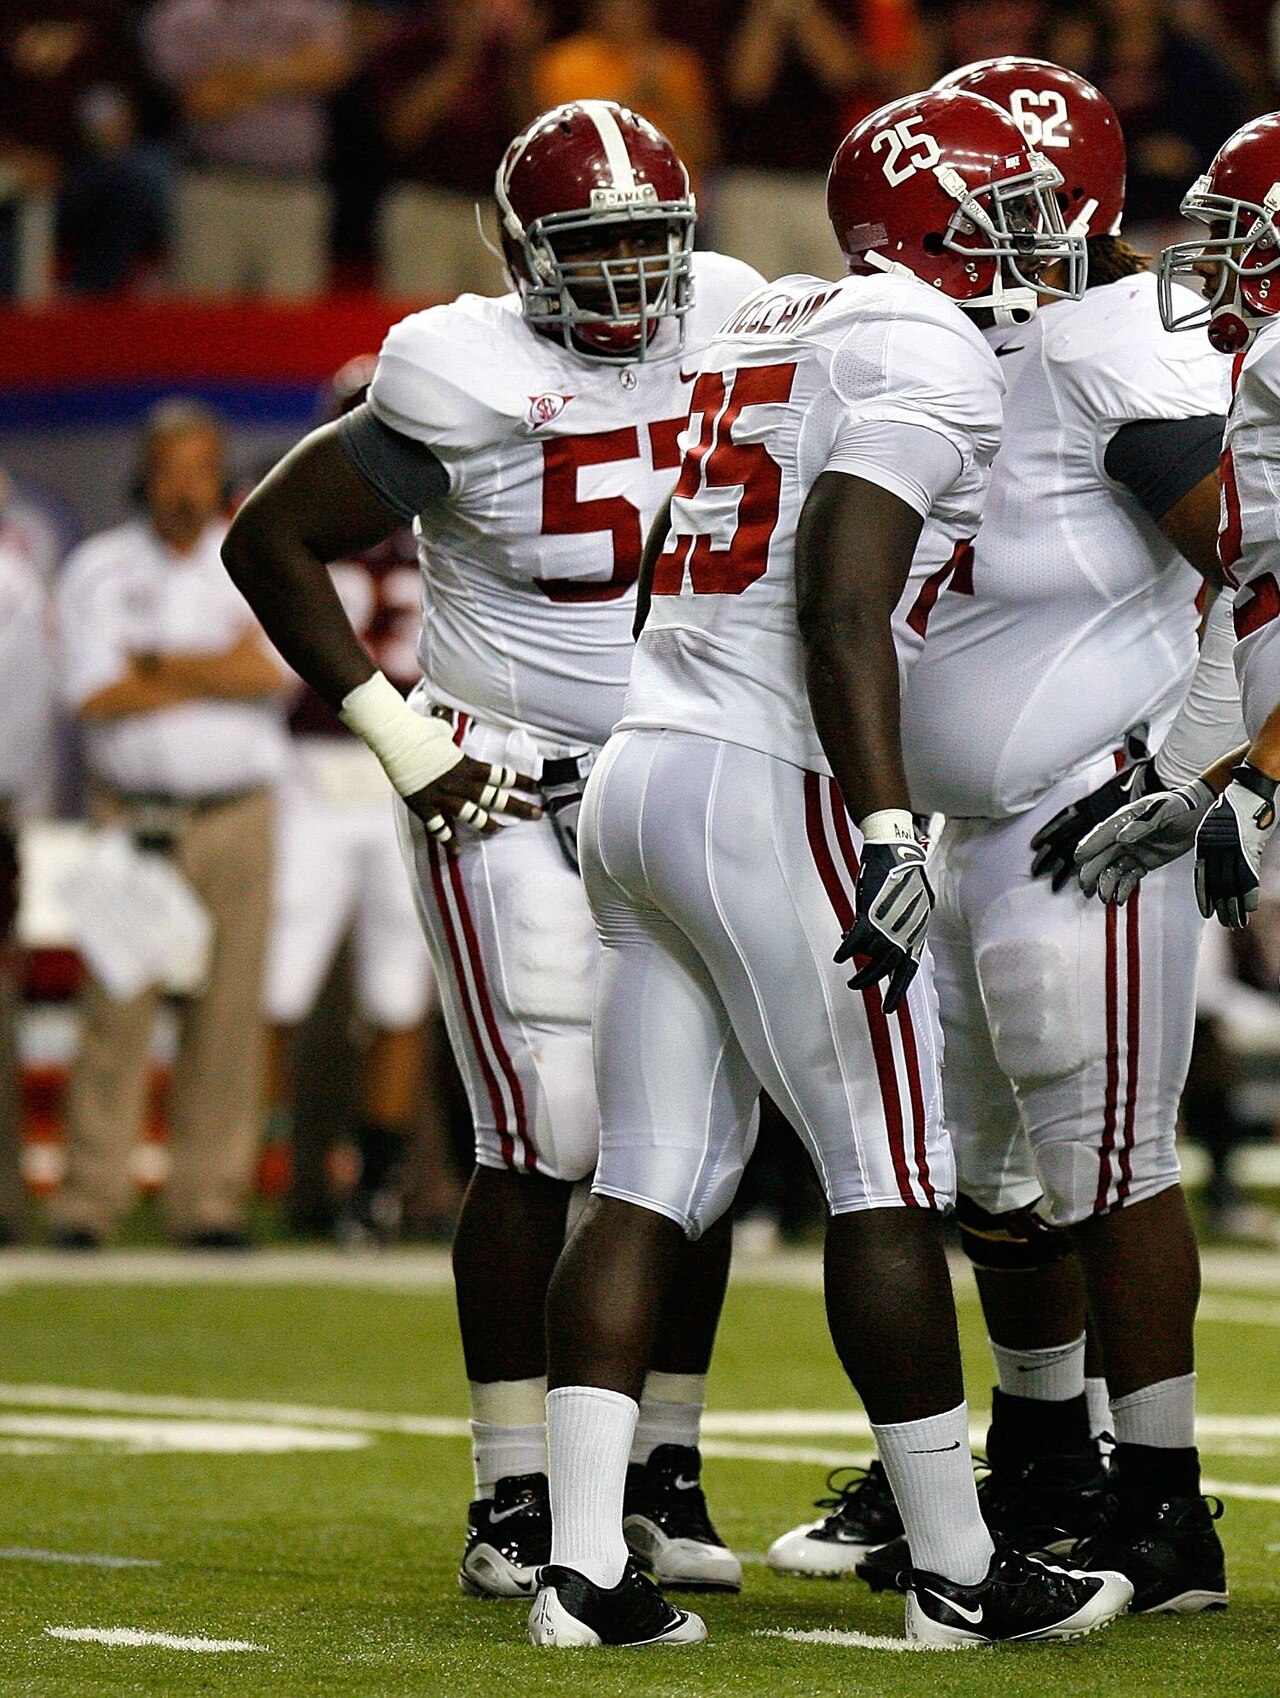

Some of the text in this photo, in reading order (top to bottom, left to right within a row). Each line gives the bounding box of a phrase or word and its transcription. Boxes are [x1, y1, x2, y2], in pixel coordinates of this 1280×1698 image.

[870, 115, 942, 188] 25
[1009, 88, 1070, 147] 62
[532, 415, 690, 604] 5
